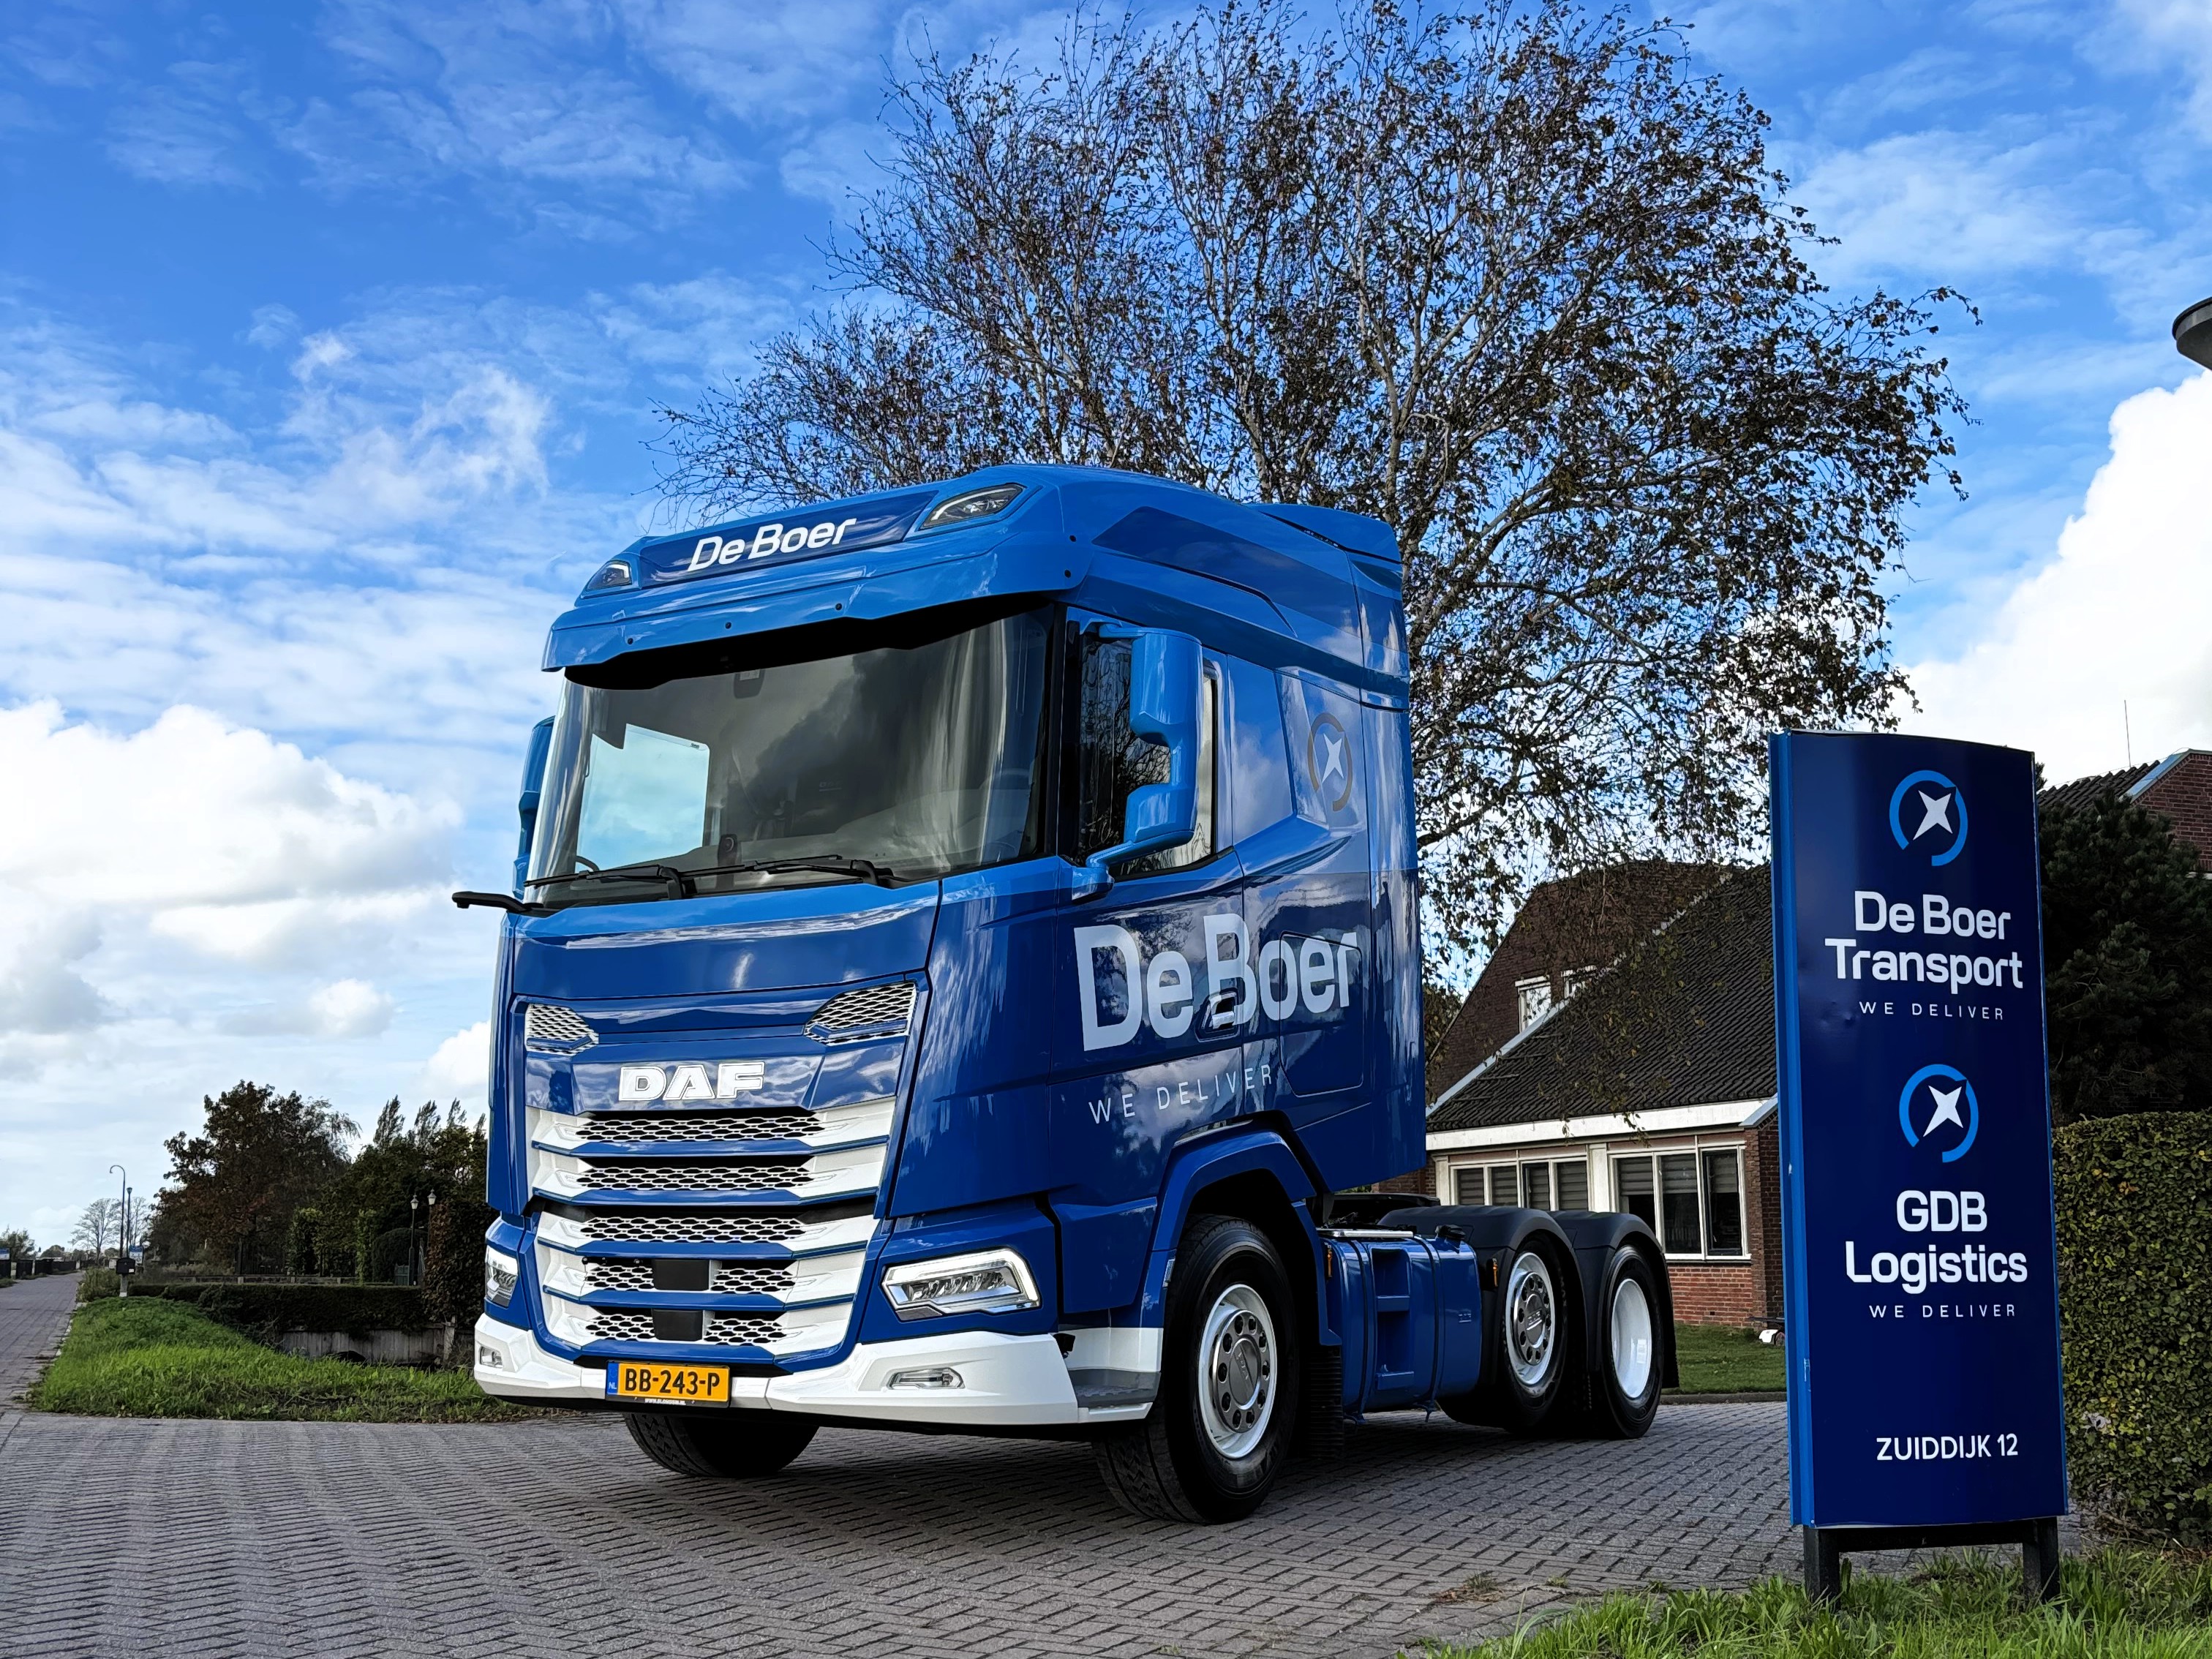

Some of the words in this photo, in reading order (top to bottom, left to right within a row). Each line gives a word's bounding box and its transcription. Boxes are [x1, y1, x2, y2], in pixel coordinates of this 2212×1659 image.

[688, 535, 744, 571] De
[748, 518, 857, 560] Boer
[1855, 891, 1915, 933] De
[1923, 895, 2011, 939] Boer
[1074, 925, 1194, 1051] De
[1203, 914, 1358, 1026] Boer
[1825, 938, 2023, 994] Transport
[1859, 1001, 1894, 1015] WE
[1912, 1004, 2003, 1020] DELIVER
[618, 1062, 765, 1101] DAF
[1088, 1094, 1136, 1124] WE
[1156, 1064, 1271, 1110] DELIVER
[1897, 1190, 1987, 1232] GDB
[1845, 1241, 2028, 1295] Logistics
[1869, 1305, 1904, 1318] WE
[1923, 1304, 2015, 1317] DELIVER
[609, 1382, 617, 1390] NL
[625, 1368, 720, 1396] BB-243-P
[1876, 1434, 1991, 1461] ZUIDDIJK
[1997, 1433, 2018, 1456] 12
